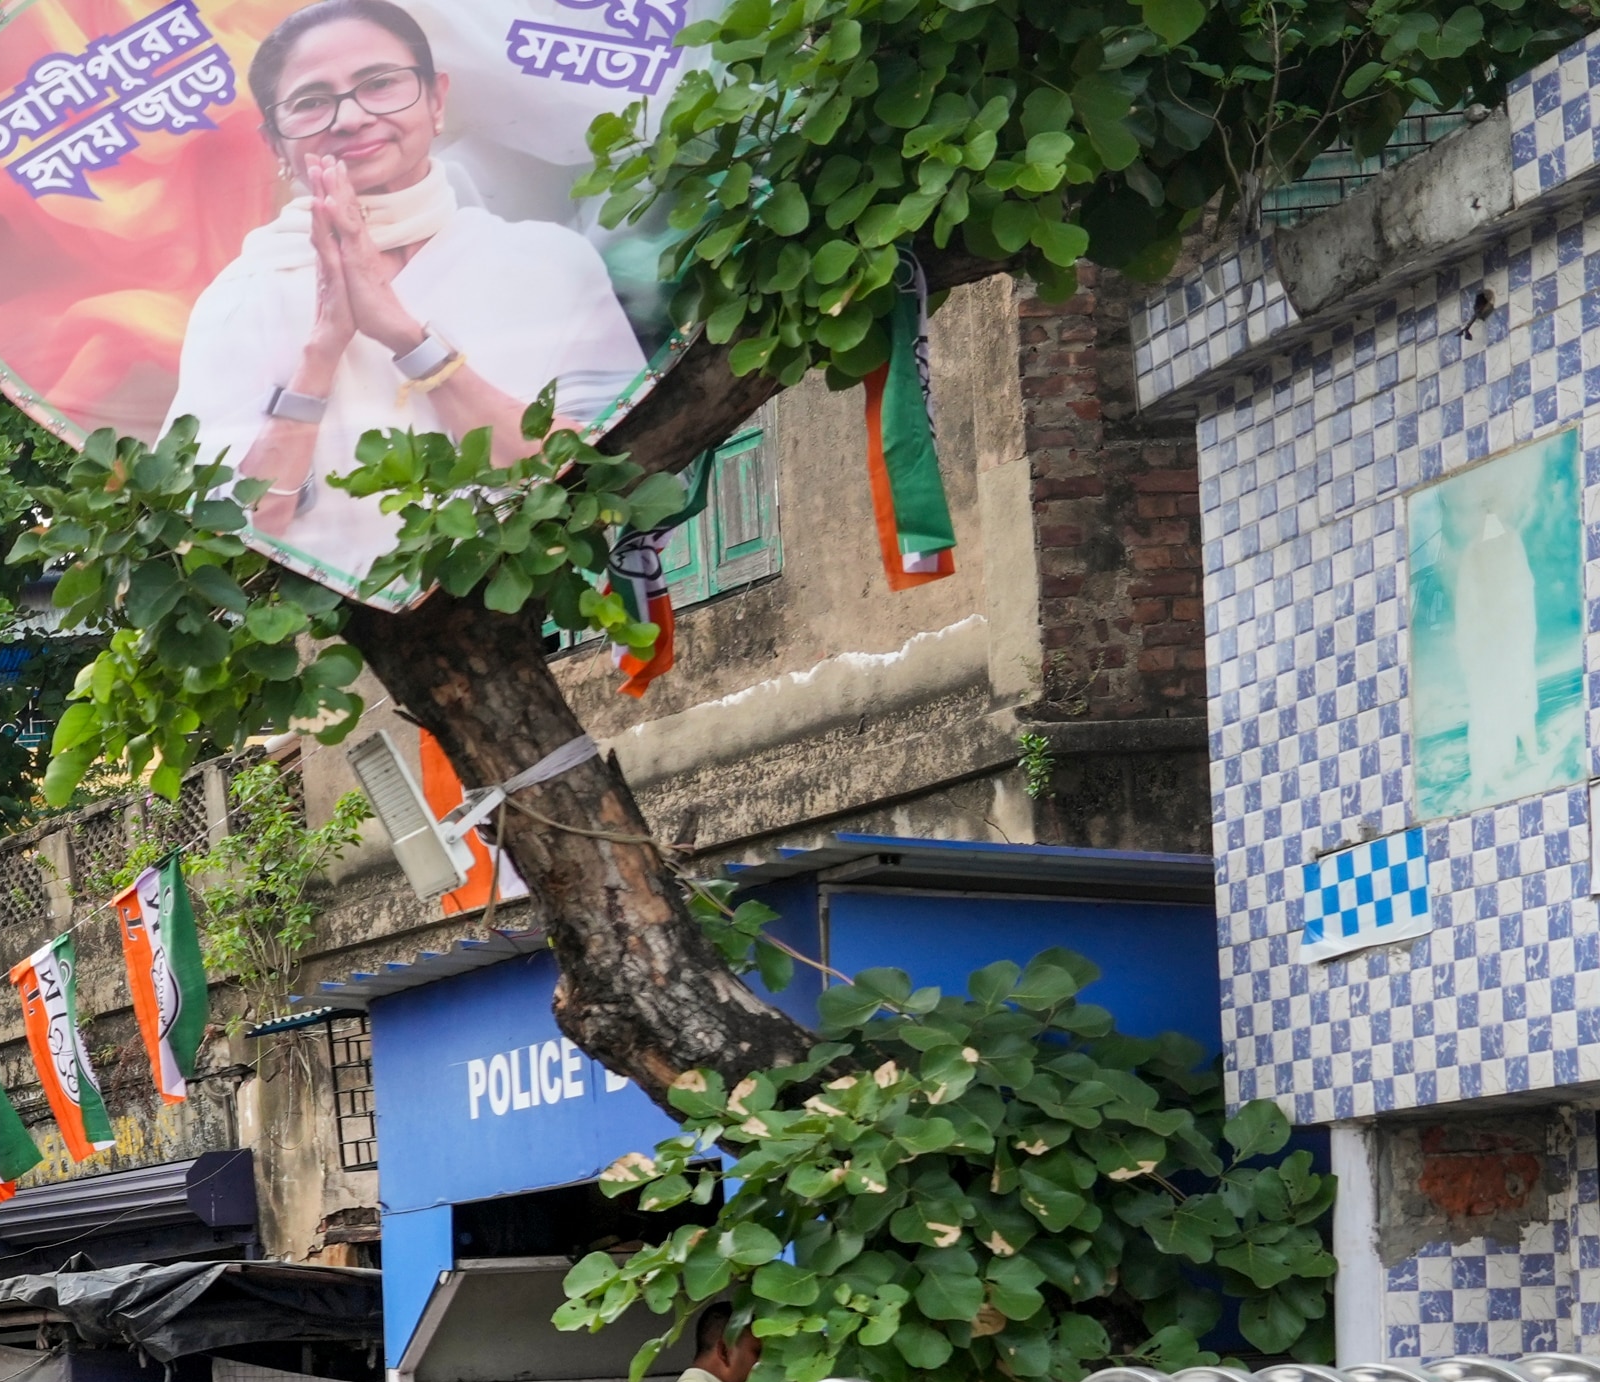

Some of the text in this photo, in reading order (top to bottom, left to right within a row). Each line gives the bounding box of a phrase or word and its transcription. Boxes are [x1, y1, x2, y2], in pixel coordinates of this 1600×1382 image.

[516, 27, 672, 87] মমতা
[16, 53, 228, 190] হৃদয় জুড়ে
[467, 1036, 584, 1119] POLICE
